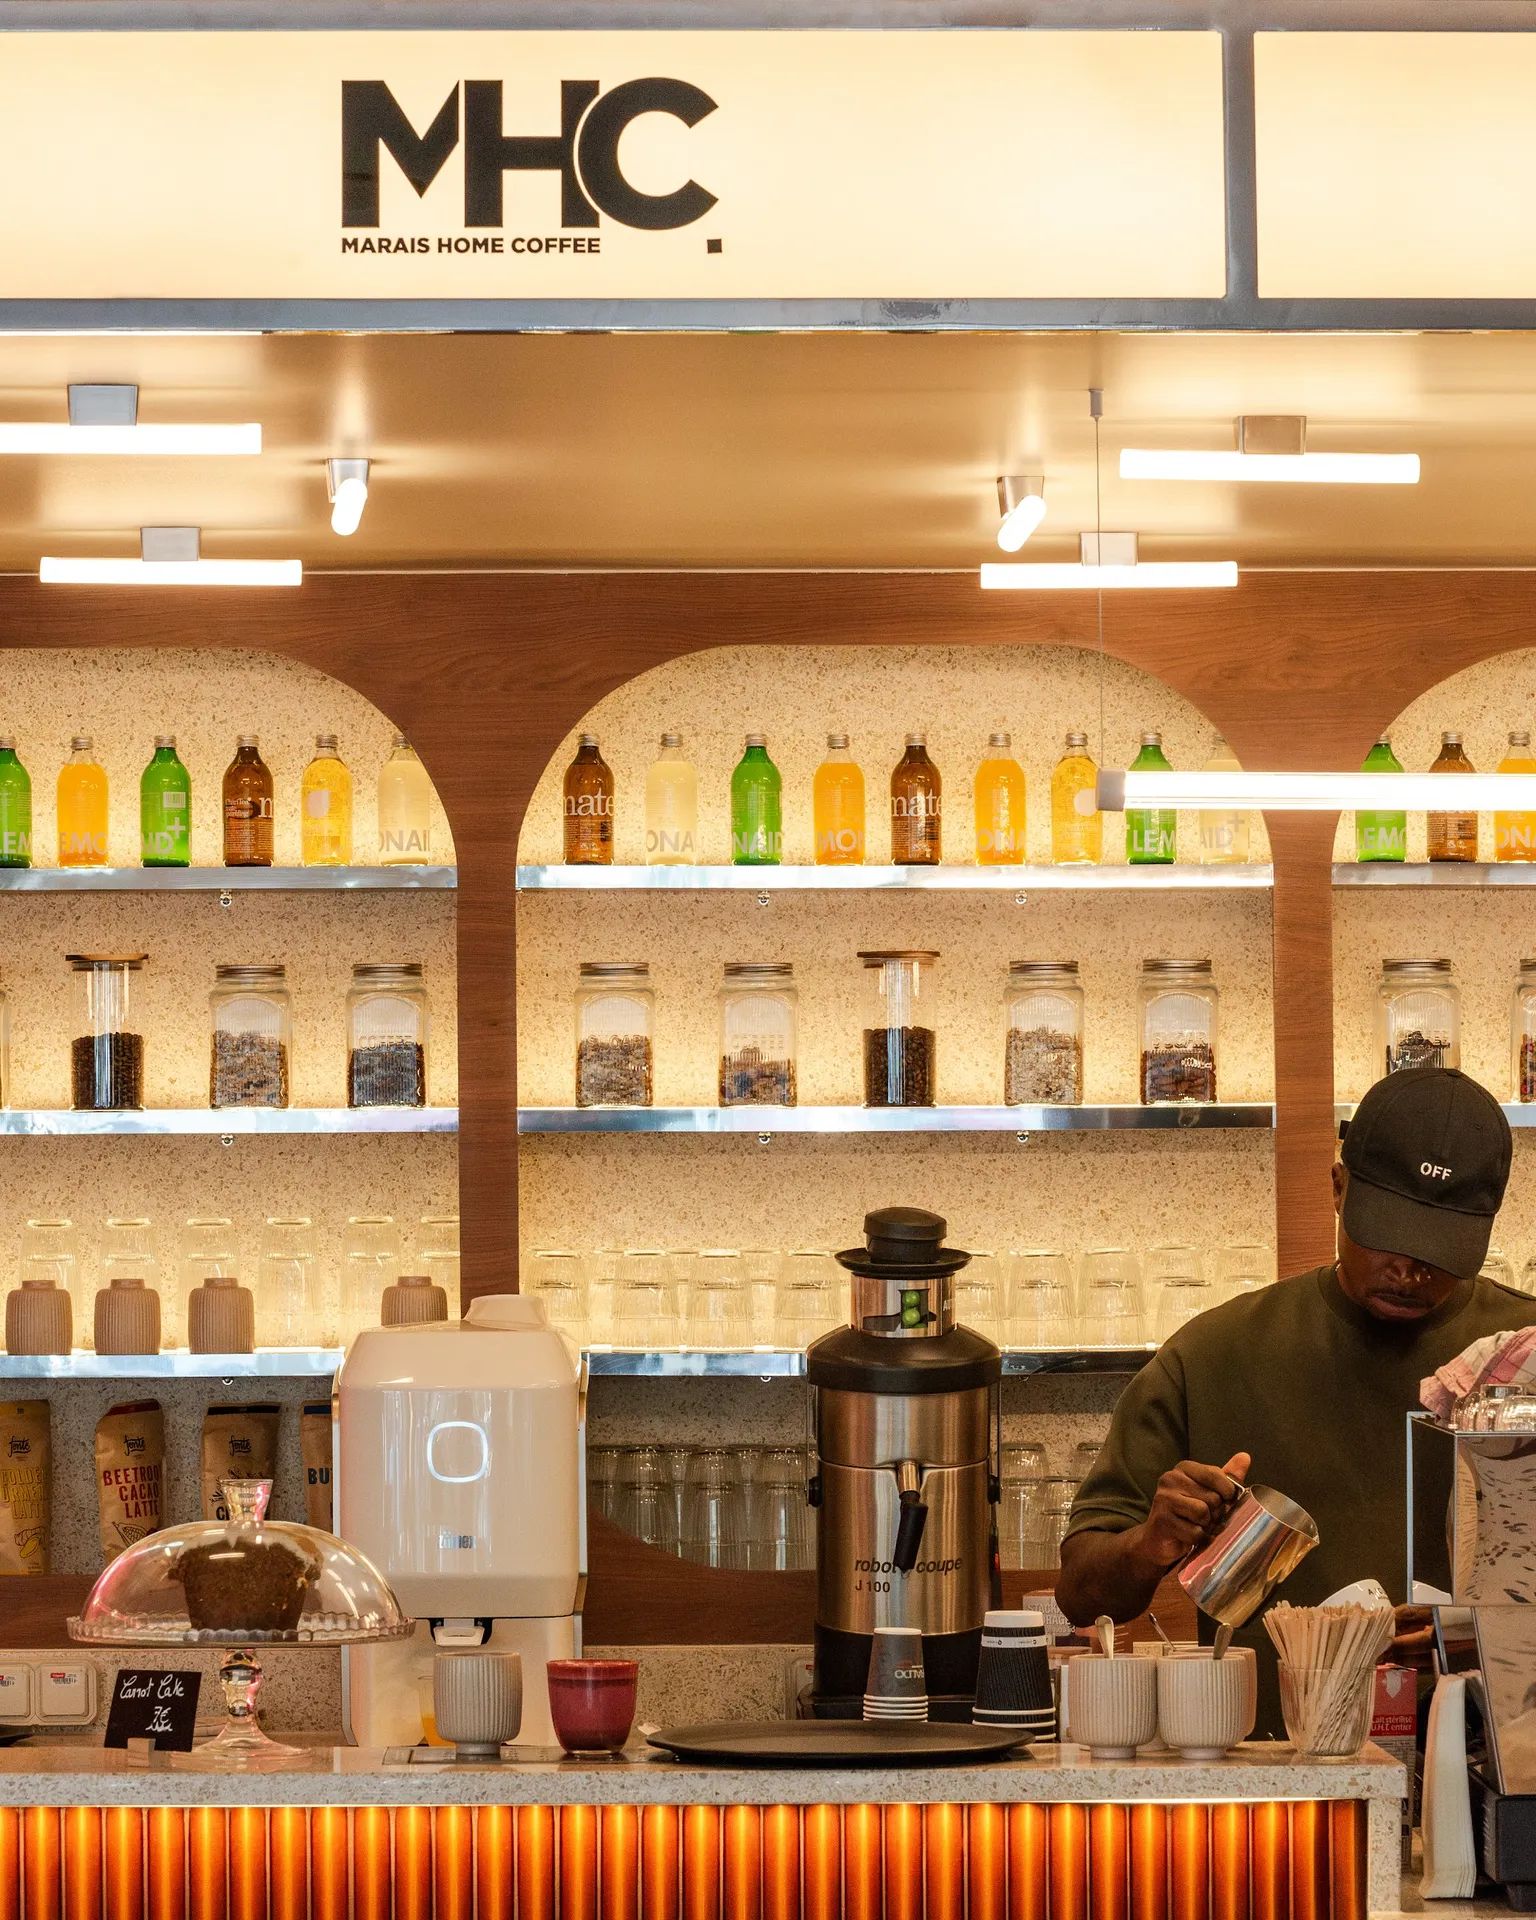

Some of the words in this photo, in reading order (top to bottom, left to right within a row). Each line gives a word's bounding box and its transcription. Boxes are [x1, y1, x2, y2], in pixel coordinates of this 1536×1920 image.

[342, 237, 431, 253] MARAIS
[437, 237, 504, 253] HOME
[511, 237, 600, 253] COFFEE
[1420, 1161, 1453, 1181] OFF
[103, 1464, 161, 1487] BEETROO
[307, 1467, 333, 1485] BU
[119, 1482, 160, 1502] CACAO
[125, 1500, 160, 1519] LATTE
[915, 1558, 963, 1576] coupe
[855, 1580, 862, 1591] J
[867, 1581, 891, 1593] 100
[120, 1675, 154, 1699] Carrot
[157, 1673, 185, 1699] Cake
